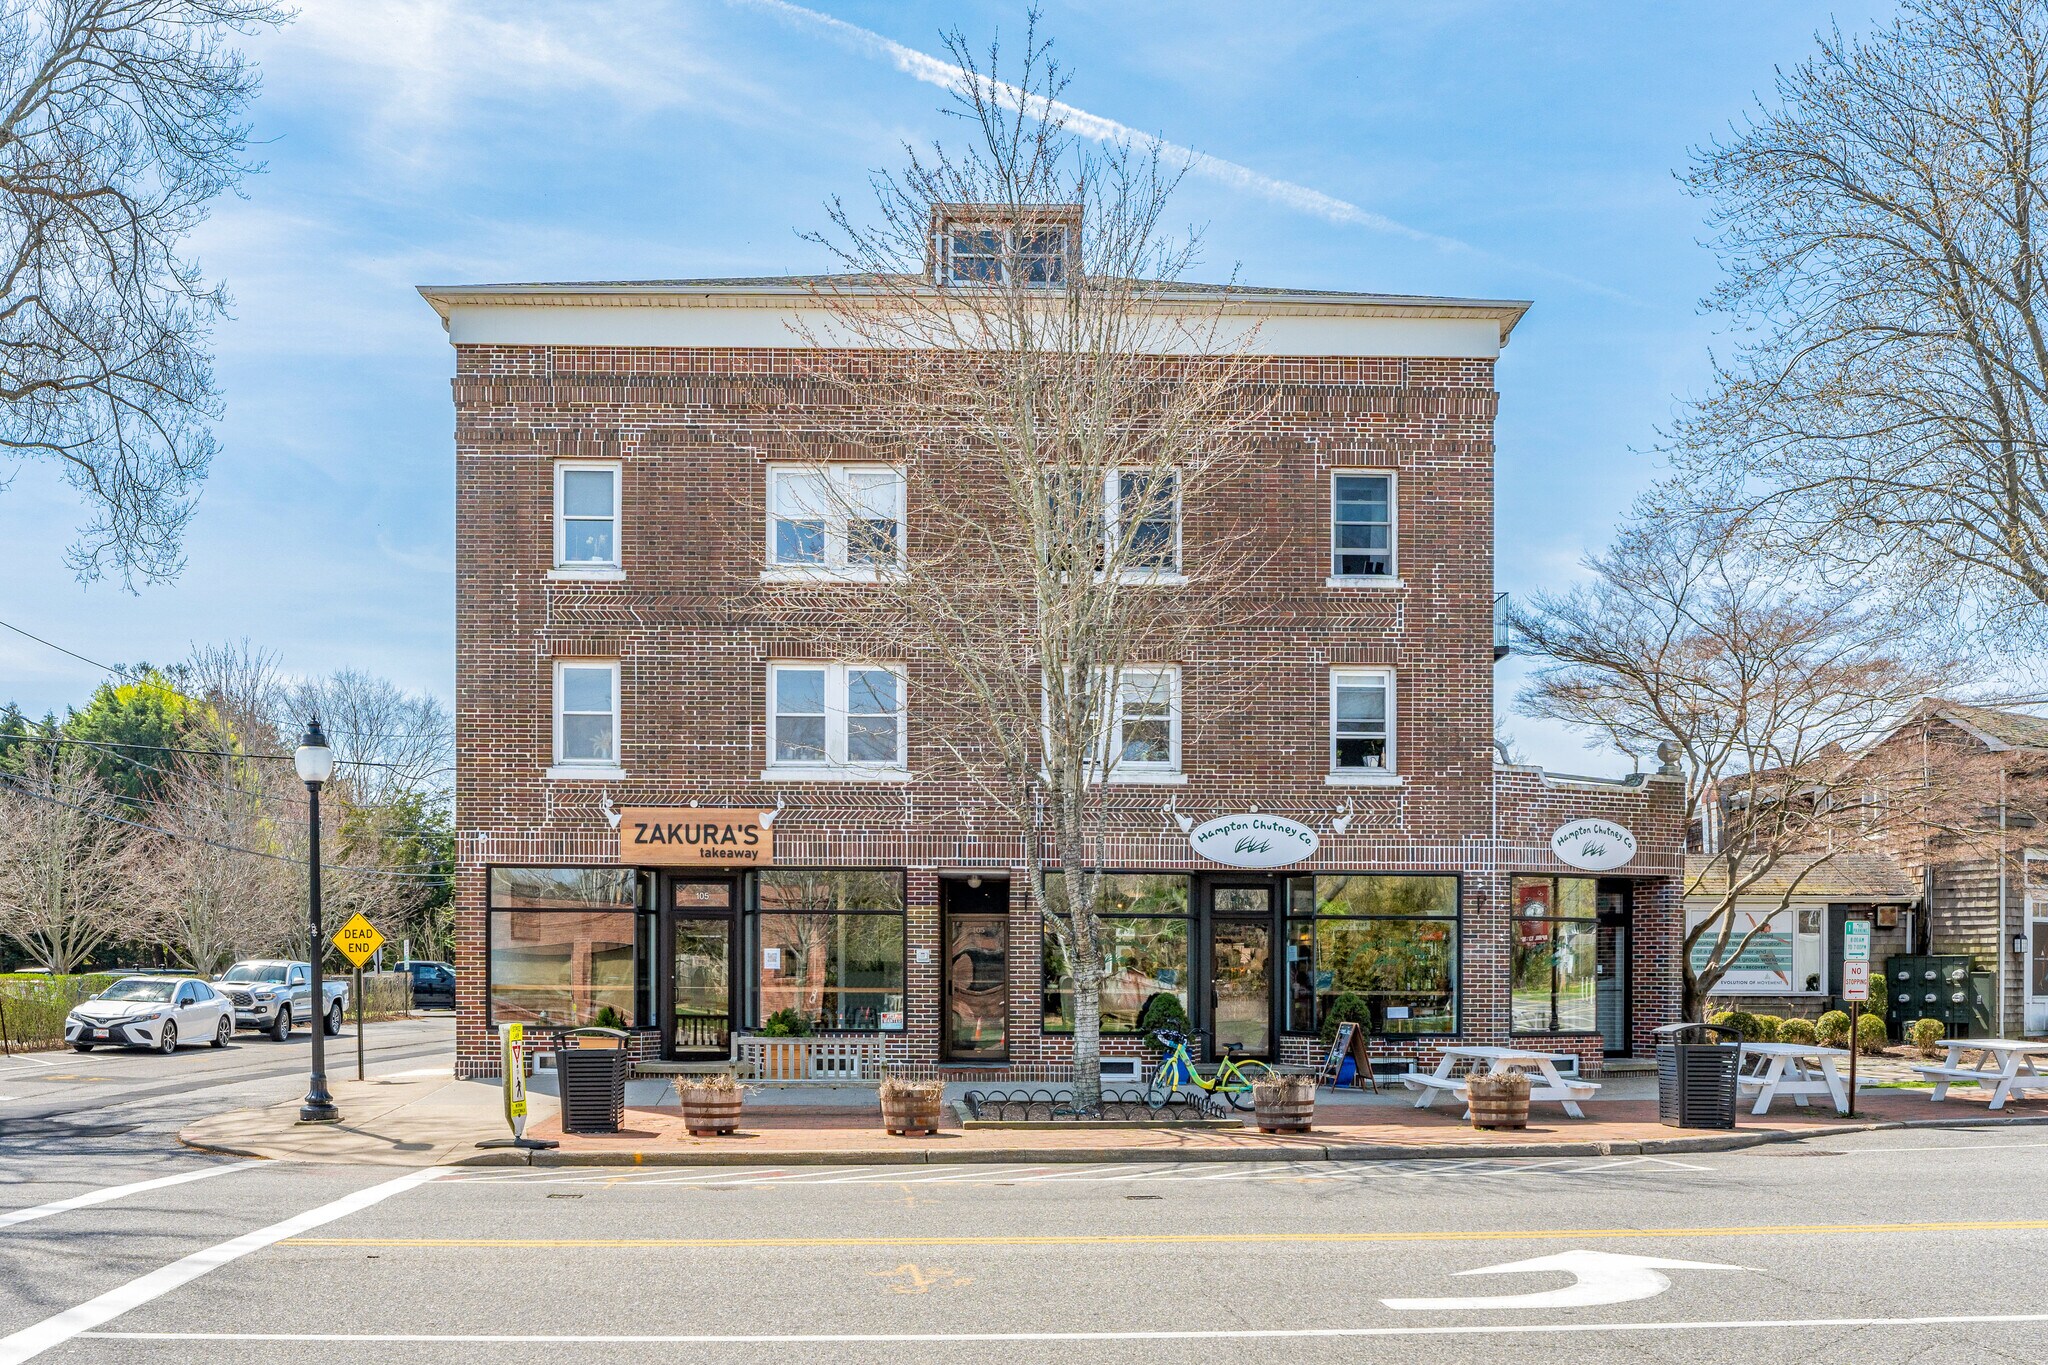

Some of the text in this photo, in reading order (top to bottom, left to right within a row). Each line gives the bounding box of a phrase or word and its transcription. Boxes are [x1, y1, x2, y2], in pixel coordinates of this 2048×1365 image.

[634, 823, 759, 845] ZAKURA'S
[1197, 819, 1312, 847] Hampton Chutney Co.
[1557, 824, 1632, 850] Hampton Chutney Co.
[700, 847, 759, 861] takeaway
[345, 929, 373, 938] DEAD
[349, 943, 369, 952] END
